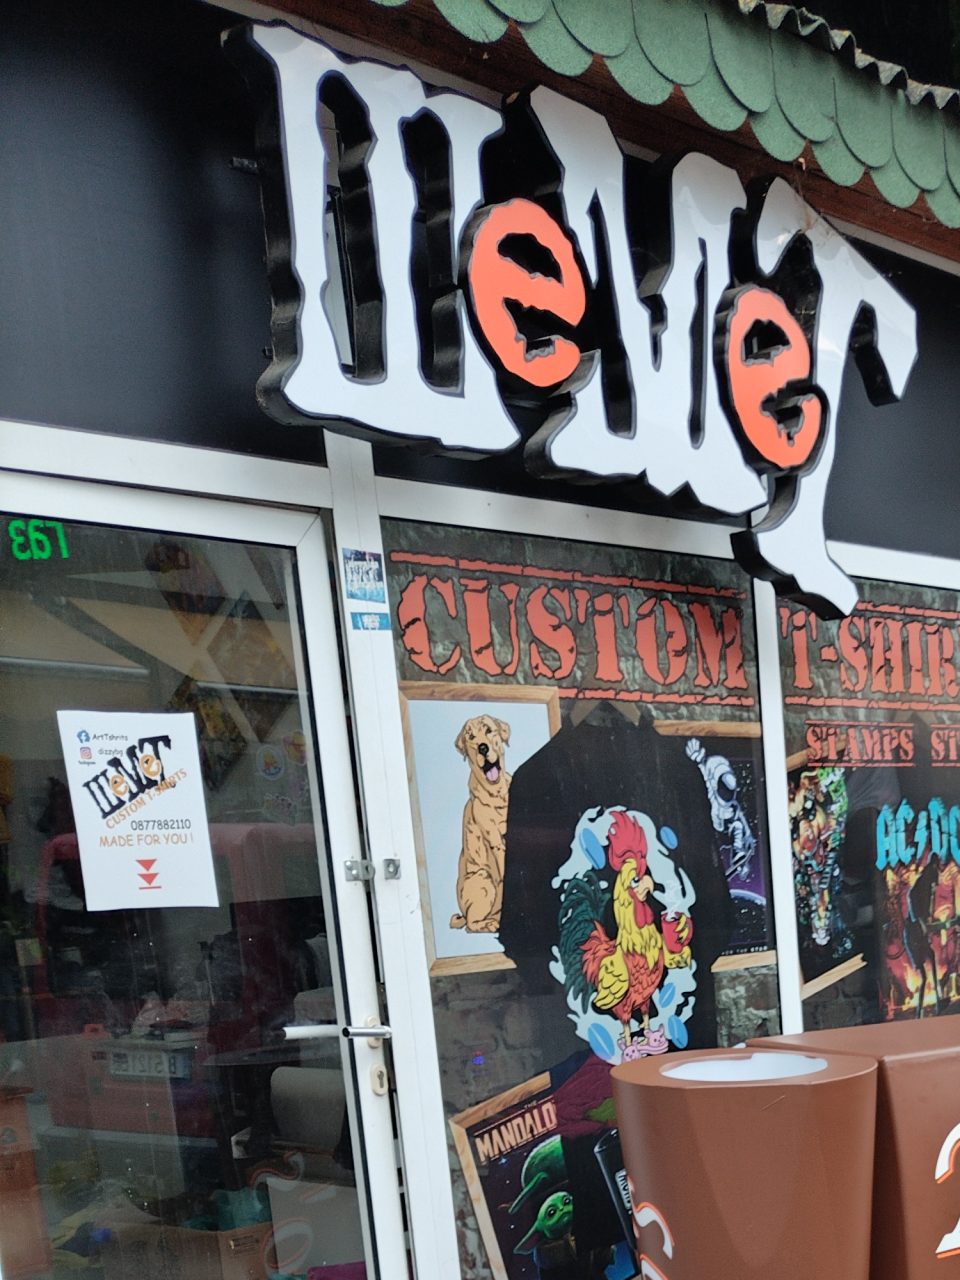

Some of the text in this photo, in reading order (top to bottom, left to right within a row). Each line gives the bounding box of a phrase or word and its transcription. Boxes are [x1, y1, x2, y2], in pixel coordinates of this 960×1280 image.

[397, 573, 749, 691] CUSTOM
[805, 726, 914, 761] STAMPS
[105, 797, 147, 830] CUSTOM
[130, 818, 191, 831] 0877882110
[99, 833, 134, 847] MADE
[137, 833, 161, 846] FOR
[164, 832, 188, 845] YOU
